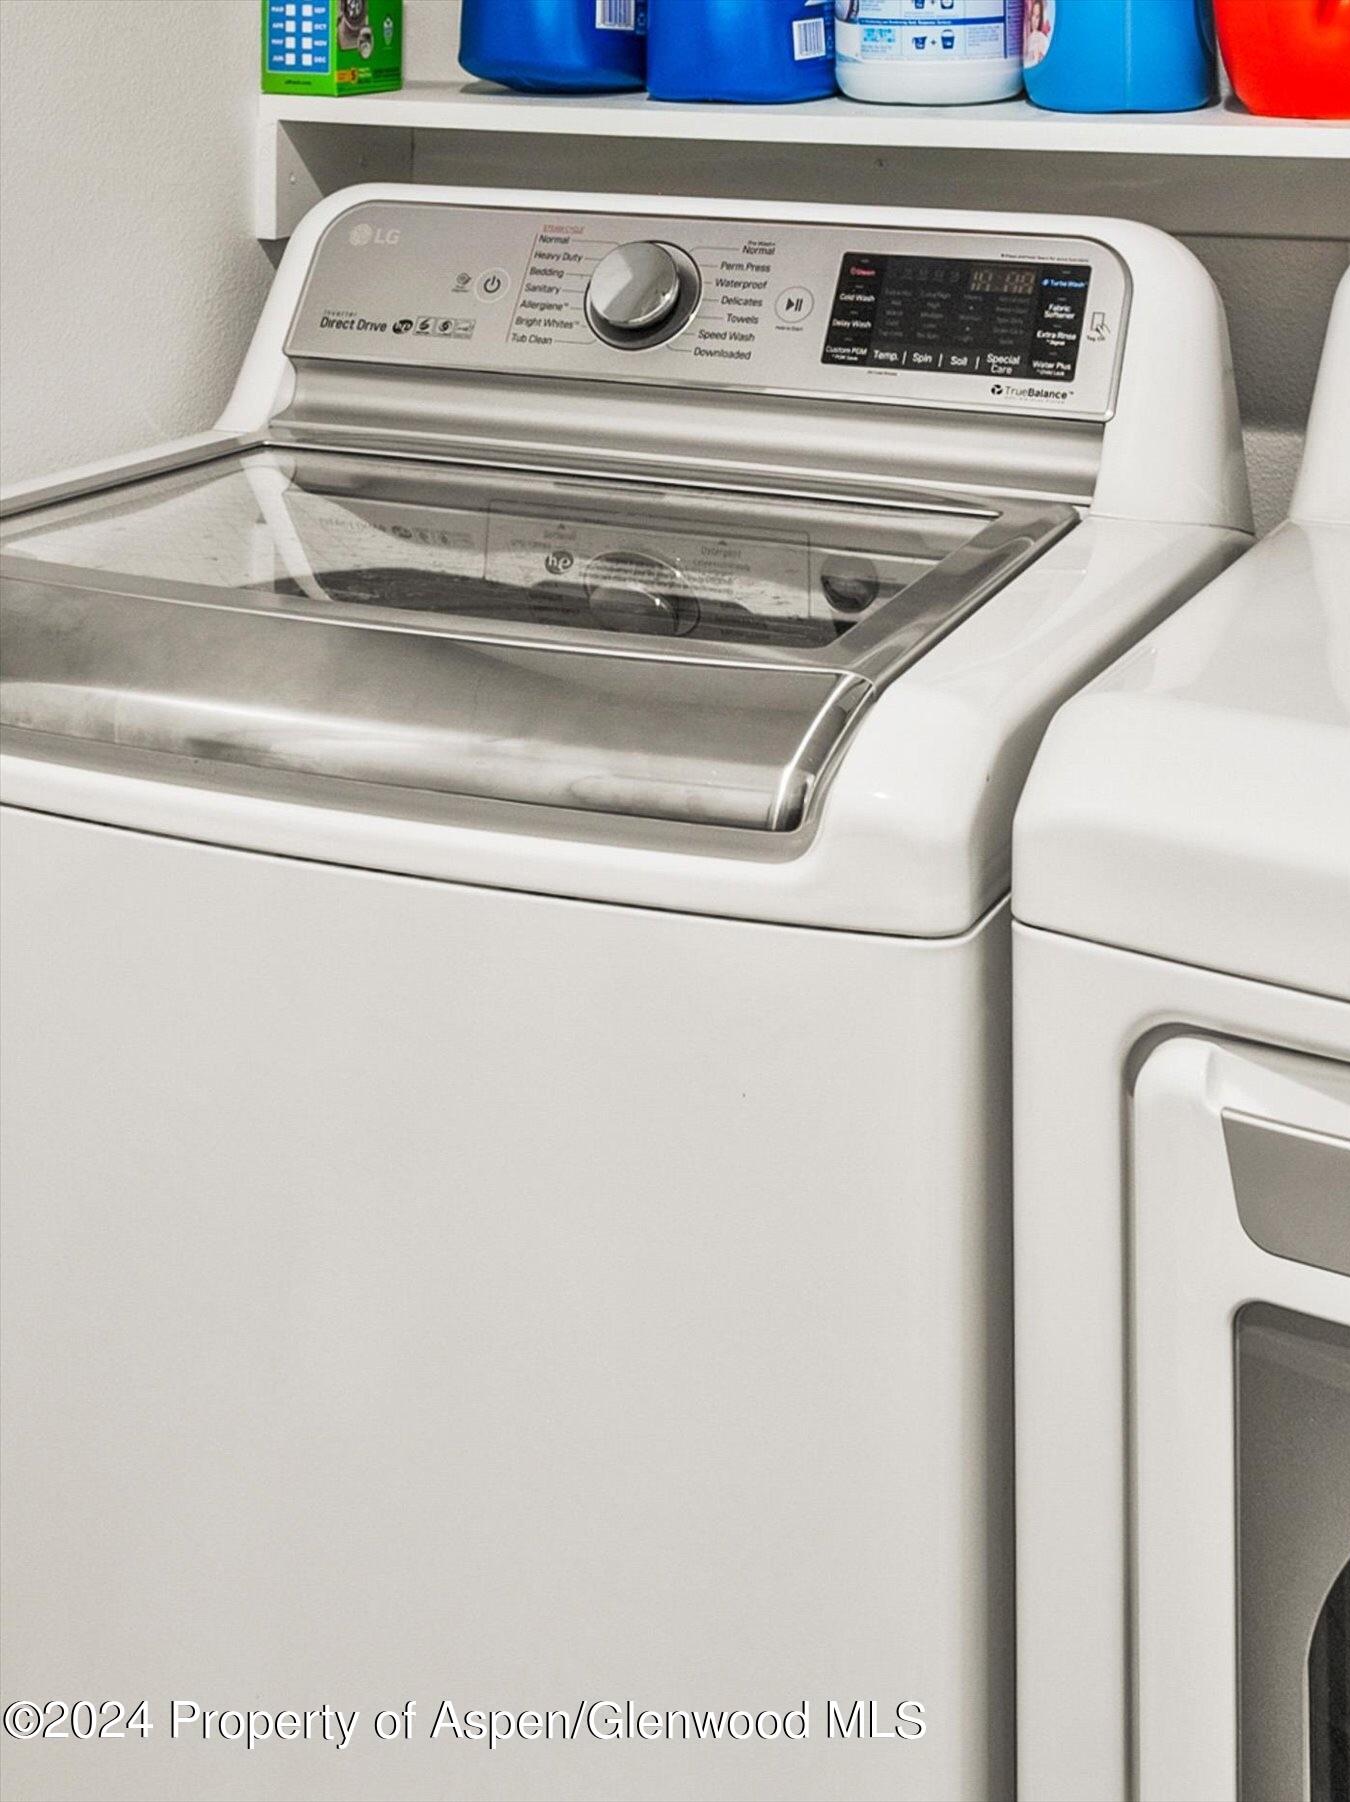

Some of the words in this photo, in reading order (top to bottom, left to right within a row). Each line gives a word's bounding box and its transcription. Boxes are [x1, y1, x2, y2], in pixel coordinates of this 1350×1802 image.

[374, 228, 401, 245] LG
[539, 234, 570, 244] Normal
[742, 245, 776, 255] Normal
[534, 250, 560, 262] Heavy
[562, 252, 583, 264] Duty
[529, 266, 565, 279] Bedding
[720, 261, 744, 271] Perm
[746, 262, 771, 273] Press
[525, 283, 561, 295] Sanitary
[715, 278, 768, 290] Waterproof
[721, 295, 763, 307] Delicates
[727, 313, 759, 325] Towels
[1044, 310, 1076, 319] Softener
[320, 316, 354, 330] Direct
[356, 318, 387, 333] Drive
[515, 315, 541, 328] Bright
[832, 318, 851, 329] Delay
[852, 320, 872, 329] Wash
[512, 333, 527, 343] Tub
[528, 334, 552, 345] Clean
[698, 329, 727, 340] Speed
[729, 331, 755, 342] Wash
[1036, 330, 1056, 339] Extra
[694, 346, 752, 360] Downloaded
[826, 345, 851, 354] Custom
[874, 349, 898, 362] Temp.
[912, 352, 932, 363] Spin
[951, 355, 967, 366] Soil
[986, 353, 1020, 366] Special
[990, 364, 1012, 374] Care
[1032, 360, 1054, 369] Water
[1056, 361, 1071, 370] Plus
[547, 555, 572, 571] he
